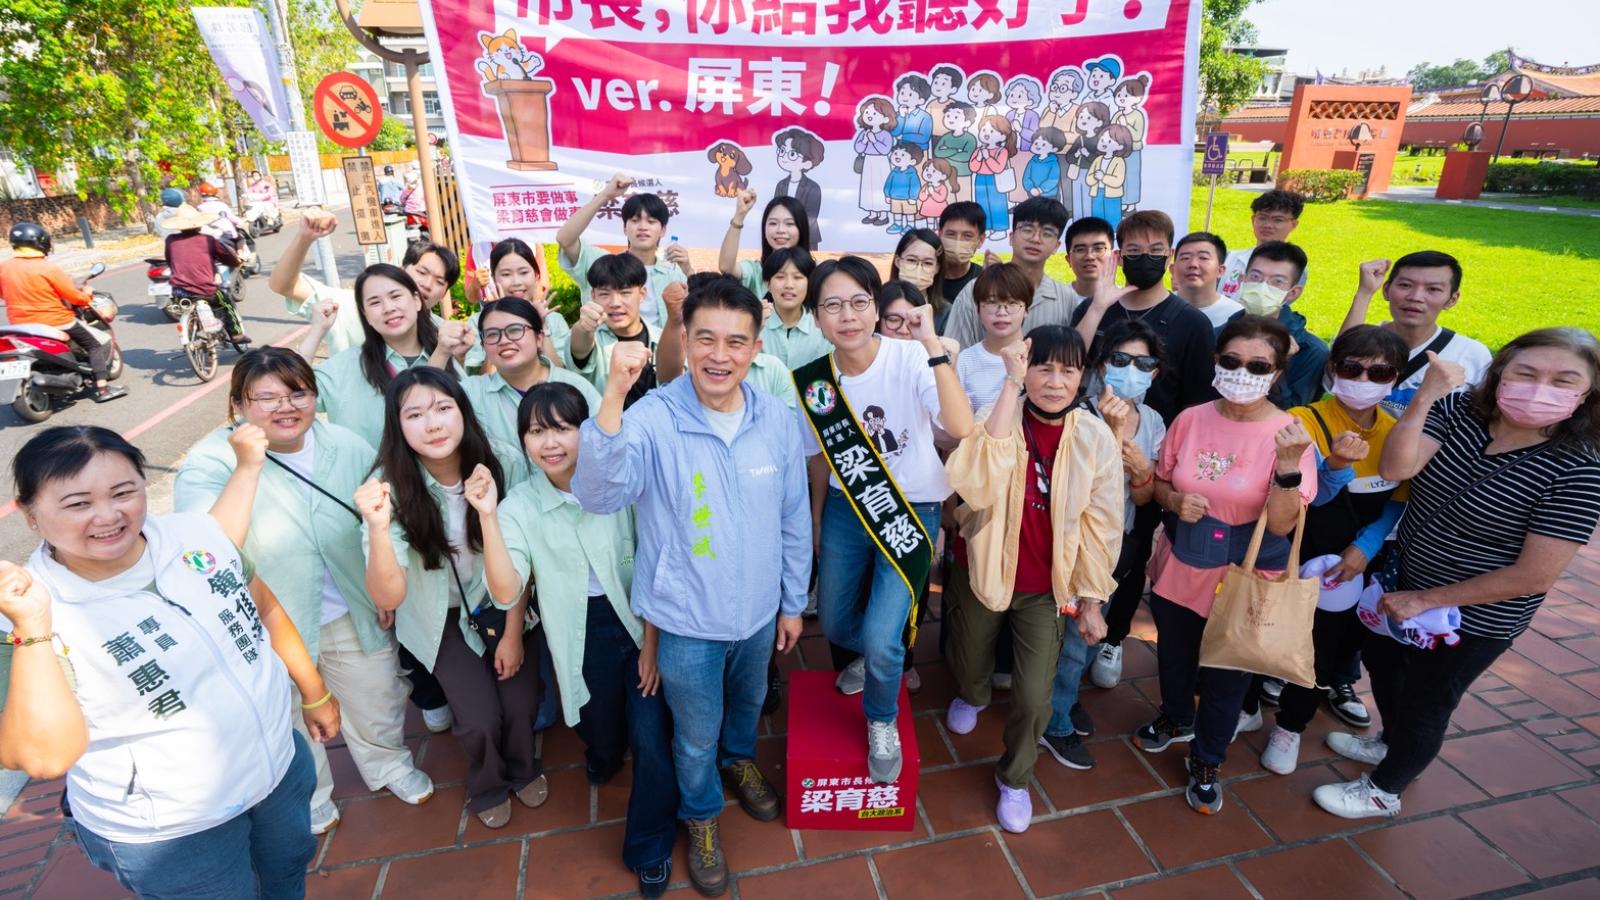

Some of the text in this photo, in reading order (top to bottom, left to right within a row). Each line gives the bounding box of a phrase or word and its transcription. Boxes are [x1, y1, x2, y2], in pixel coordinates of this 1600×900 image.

[571, 57, 840, 116] ver. 屏東!
[360, 161, 384, 241] 禁止汽機車進入
[493, 190, 578, 207] 屏東市要做事
[597, 190, 680, 219] 梁慈
[833, 444, 924, 559] 梁育慈
[136, 615, 180, 652] 專員
[217, 608, 258, 665] 服務團隊
[101, 631, 188, 721] 蕭惠君
[800, 785, 900, 813] 梁育慈
[816, 776, 899, 787] 屏東市長候
